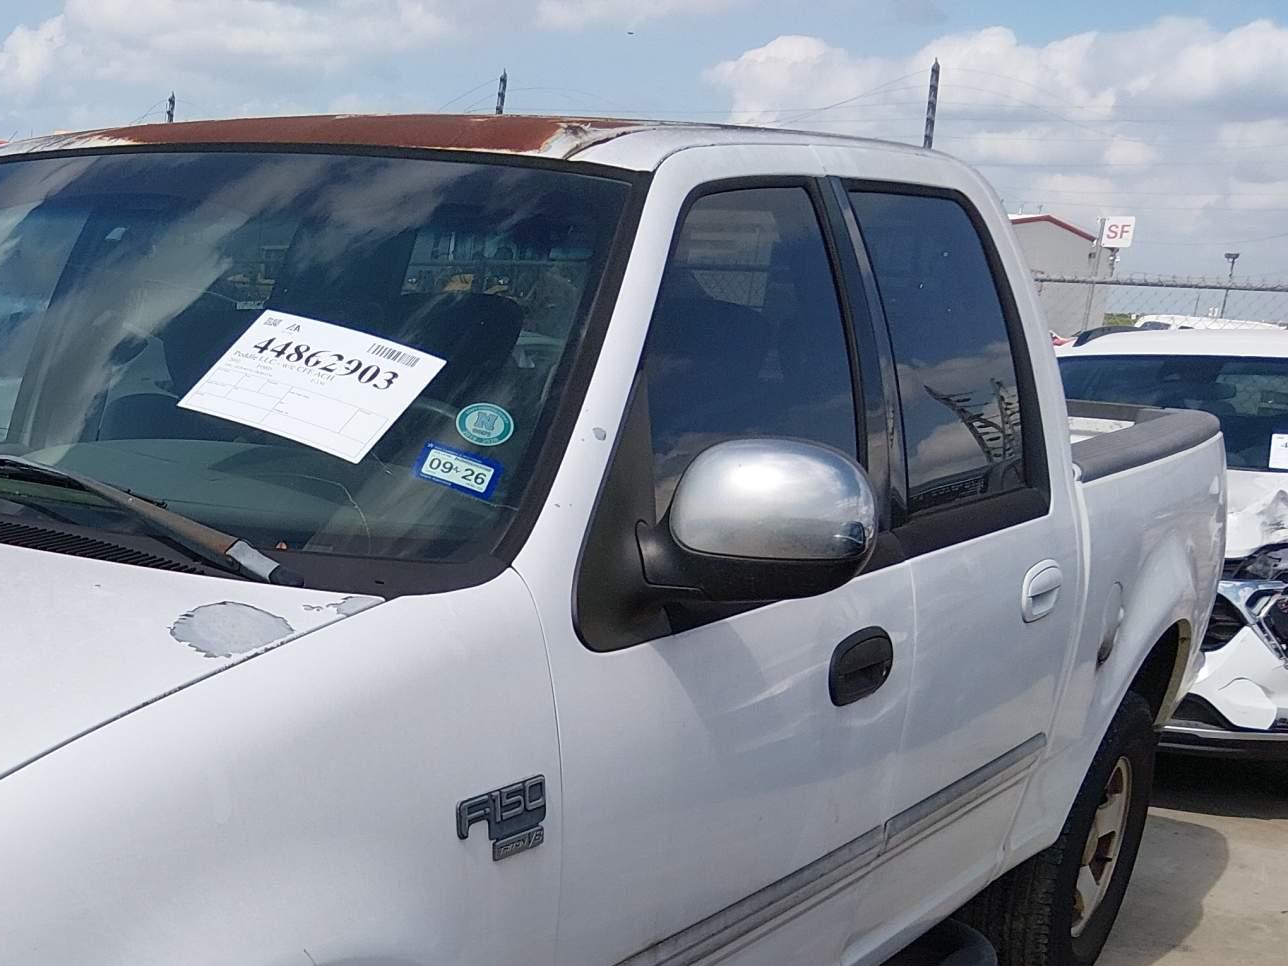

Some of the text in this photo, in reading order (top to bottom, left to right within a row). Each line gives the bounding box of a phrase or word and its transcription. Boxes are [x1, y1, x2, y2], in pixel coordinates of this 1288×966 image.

[1106, 224, 1131, 239] SF
[253, 336, 399, 391] 44862903
[428, 457, 453, 474] 09
[461, 468, 487, 486] 26
